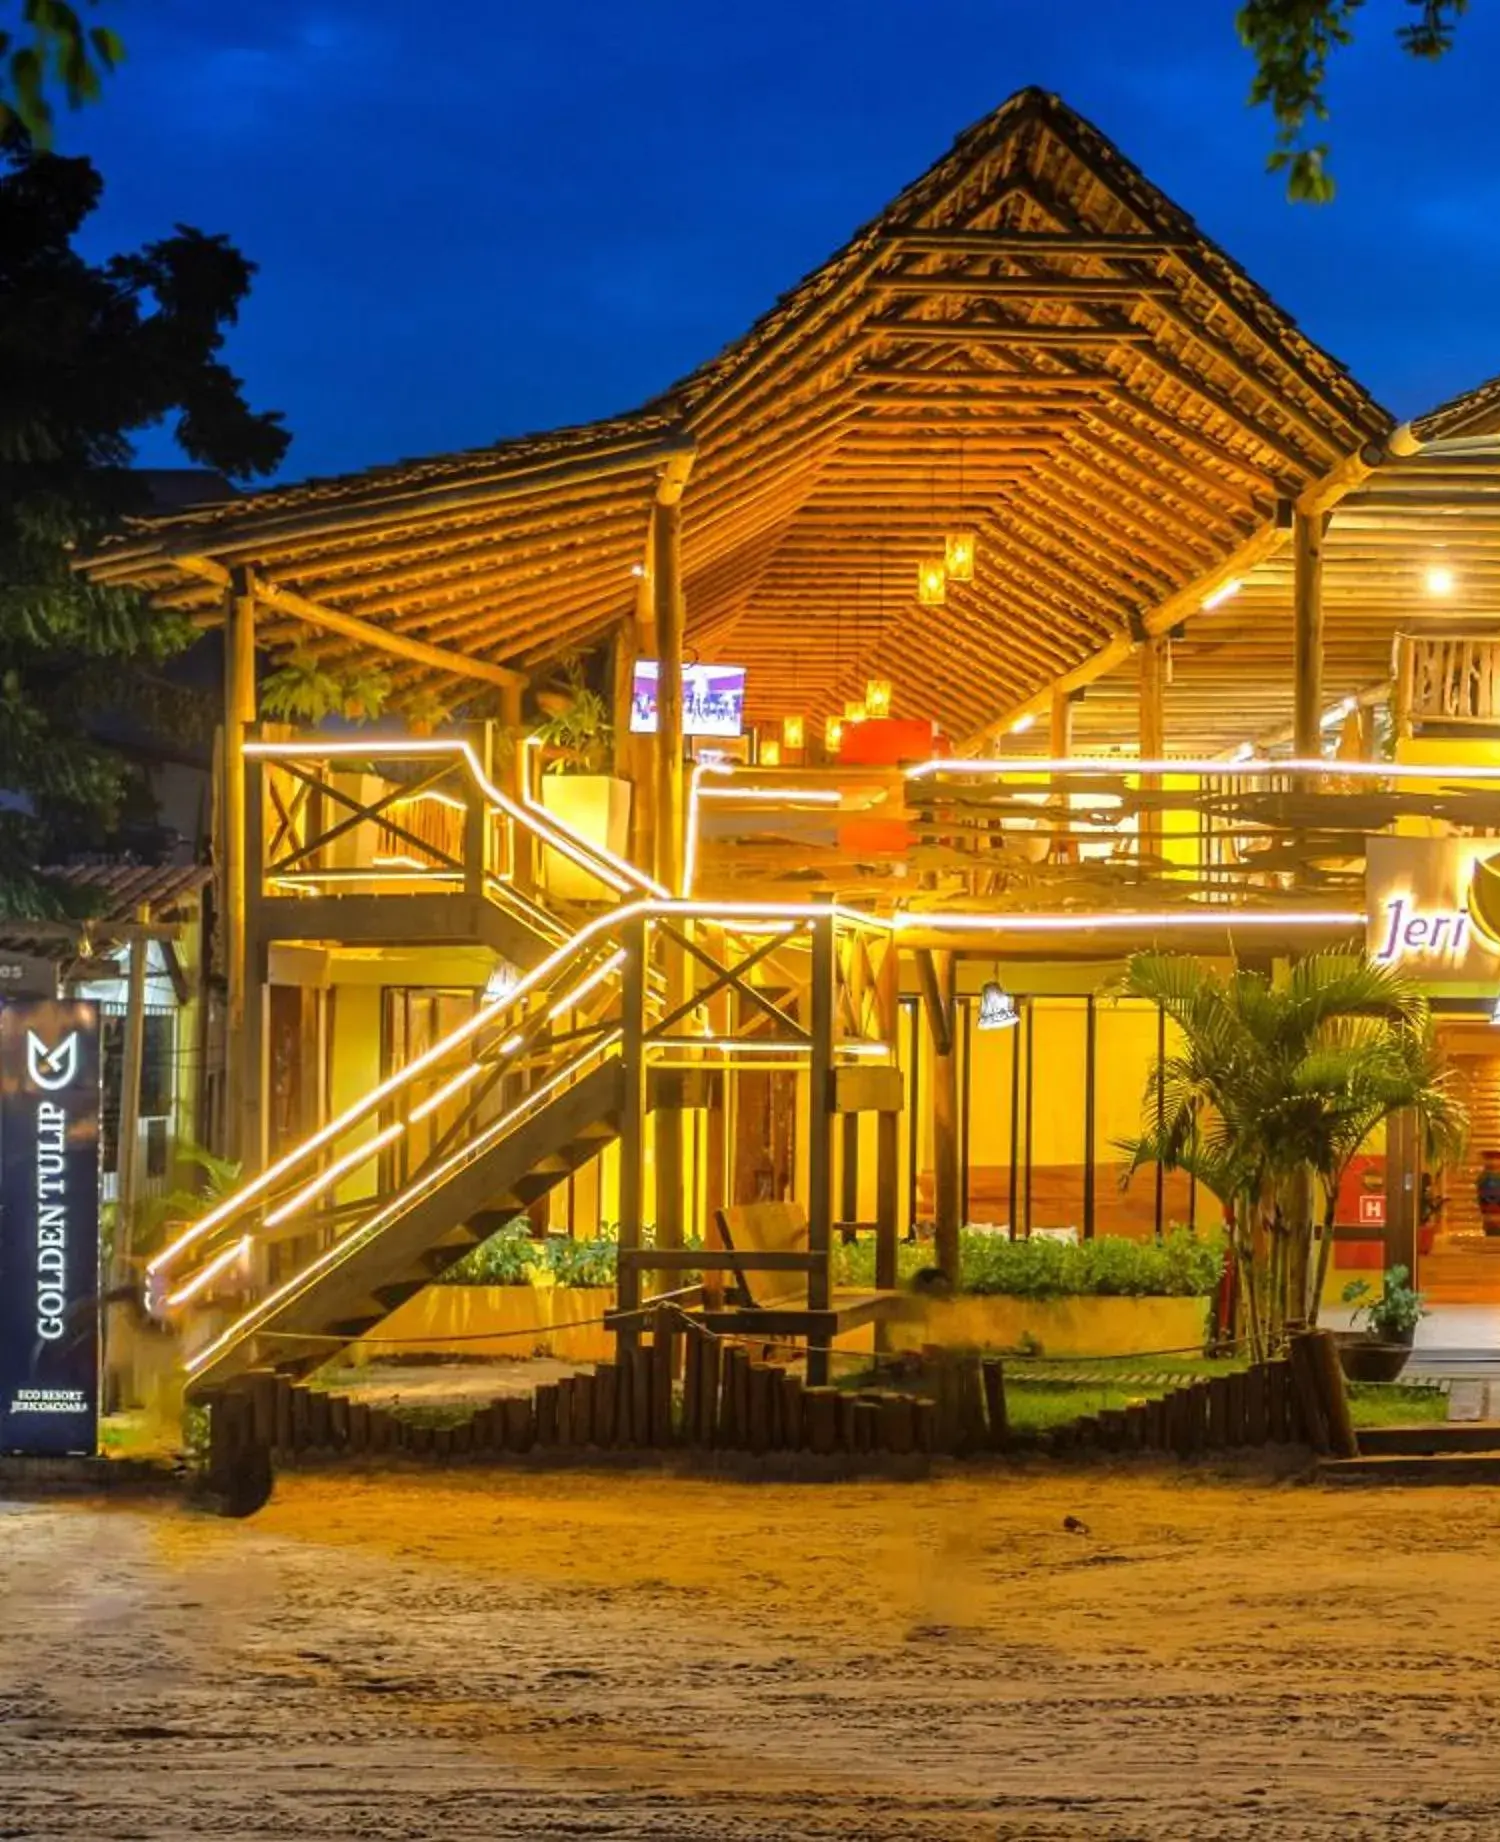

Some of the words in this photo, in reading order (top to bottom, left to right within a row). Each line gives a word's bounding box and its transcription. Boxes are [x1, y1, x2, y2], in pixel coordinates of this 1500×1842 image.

[1378, 900, 1468, 958] Jeri
[37, 1102, 65, 1199] TULIP
[1366, 1201, 1381, 1217] H
[37, 1202, 65, 1340] GOLDEN
